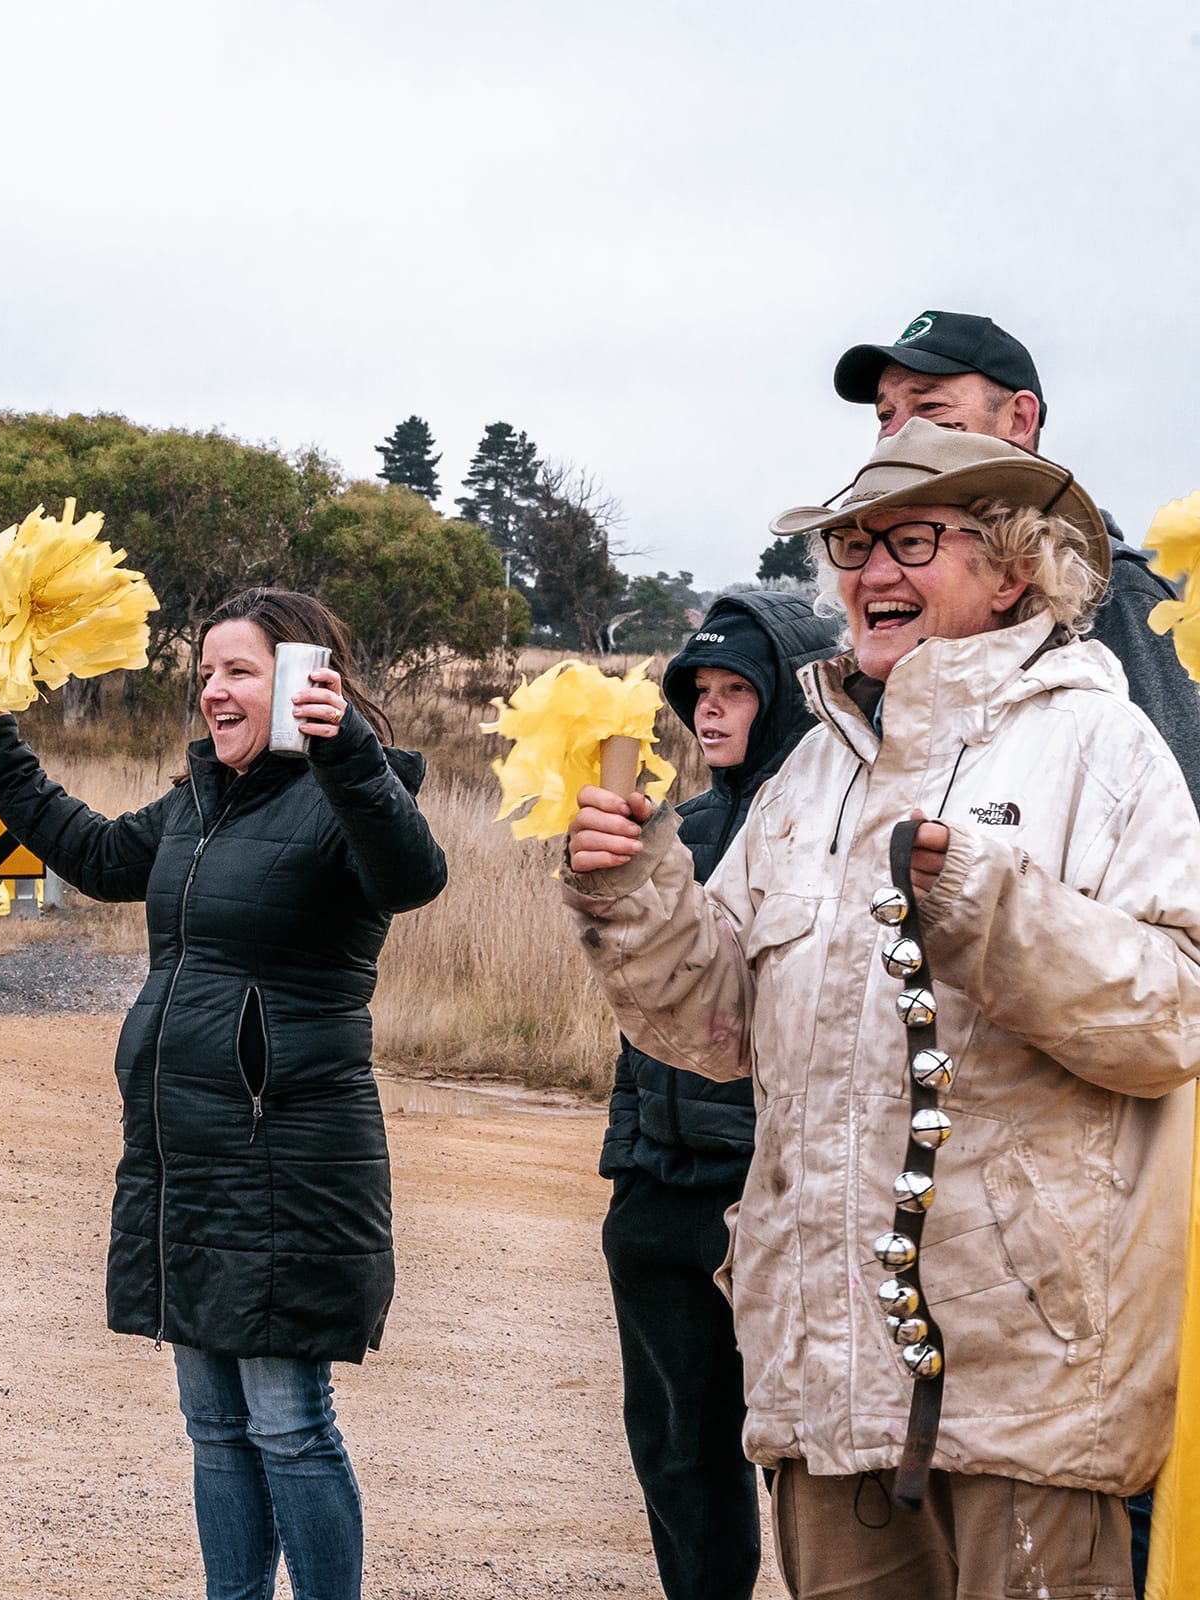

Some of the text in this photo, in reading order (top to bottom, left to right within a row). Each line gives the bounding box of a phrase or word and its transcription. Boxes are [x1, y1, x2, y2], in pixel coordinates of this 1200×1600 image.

[988, 801, 1006, 810] THE
[969, 807, 1004, 817] NORTH
[977, 815, 1003, 825] FACE
